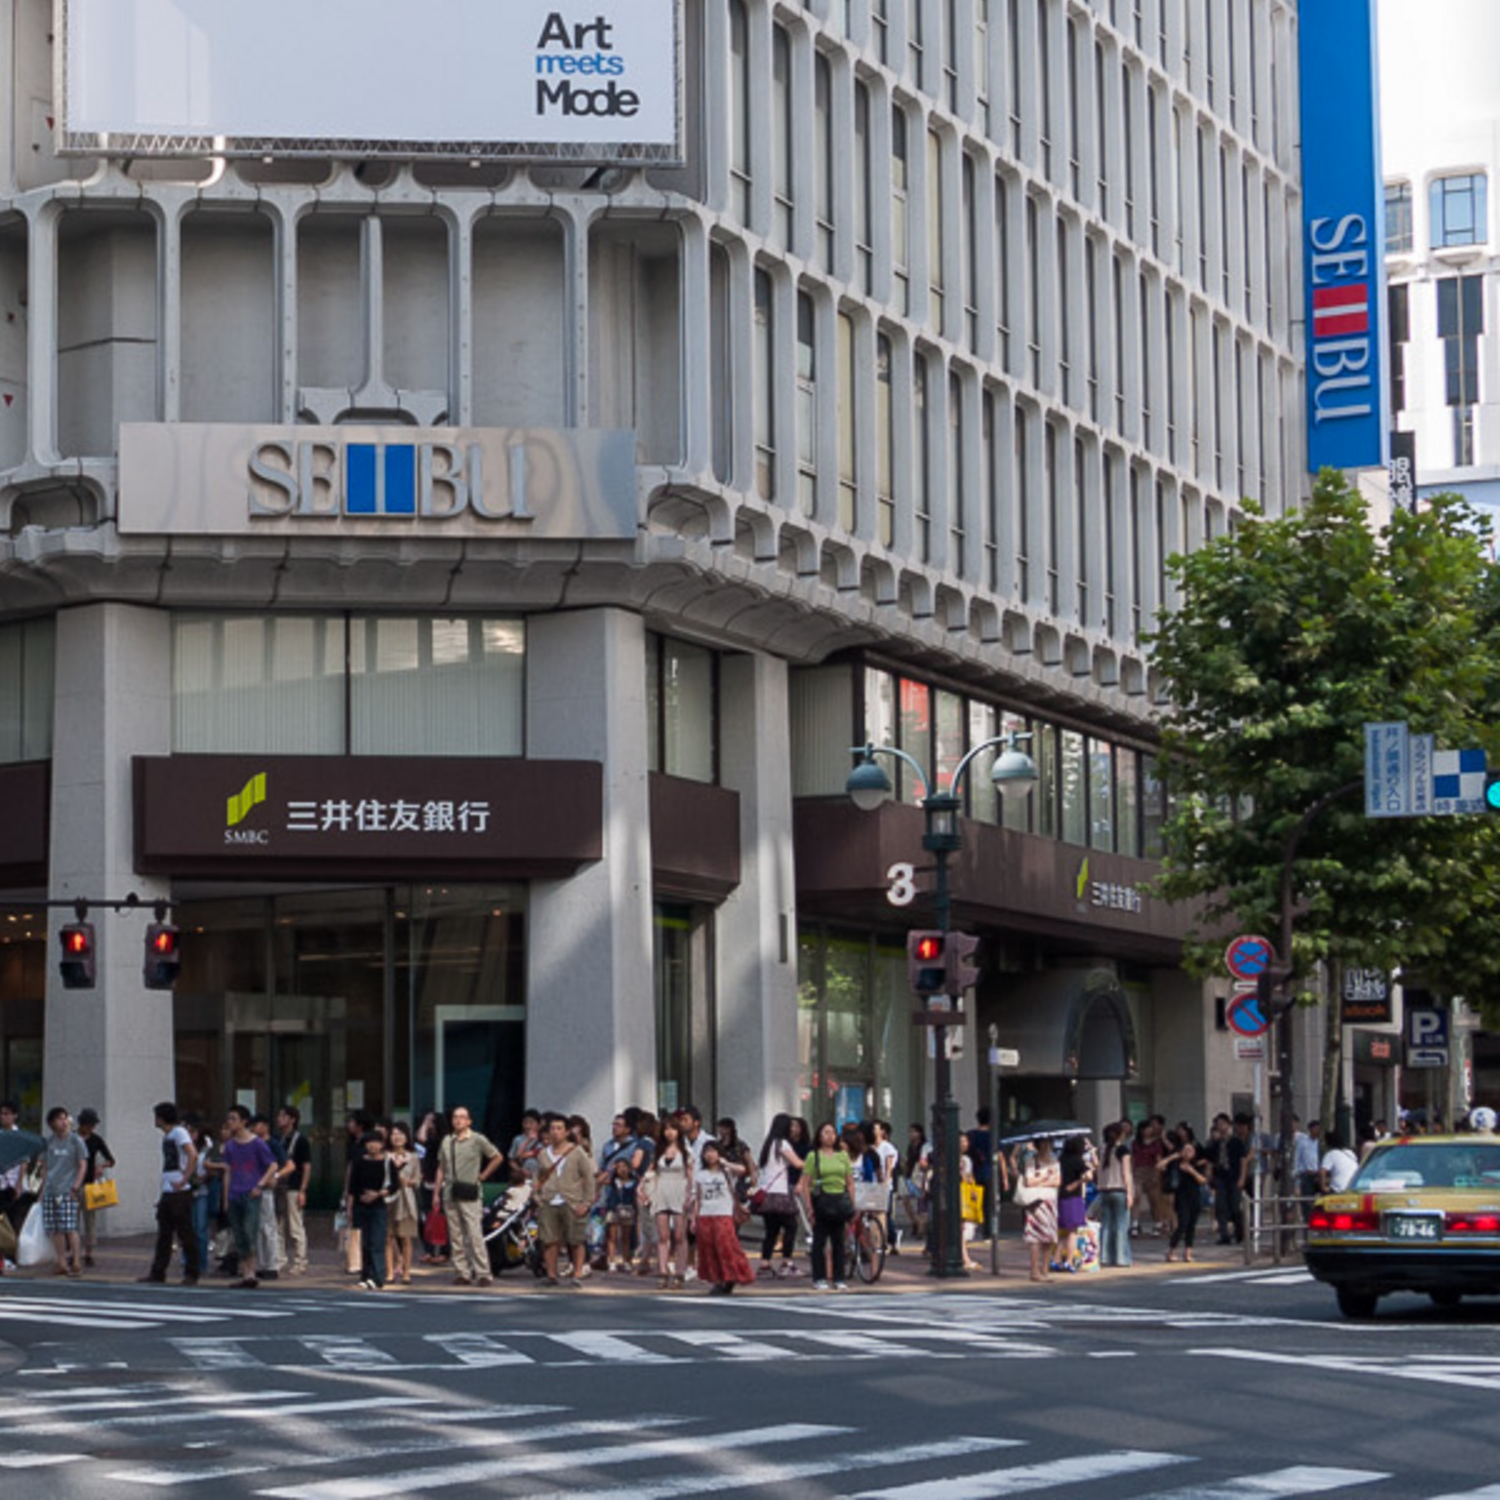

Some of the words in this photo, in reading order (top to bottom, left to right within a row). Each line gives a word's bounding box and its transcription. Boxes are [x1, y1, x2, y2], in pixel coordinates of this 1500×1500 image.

[537, 12, 614, 49] Art
[536, 52, 625, 75] meets
[536, 79, 640, 118] Mode
[1309, 213, 1374, 426] SEIBU
[247, 439, 535, 523] SEIBU
[286, 799, 491, 834] 三井住友銀行
[224, 828, 269, 845] SMBC
[887, 861, 916, 906] 3
[1412, 1011, 1440, 1045] P
